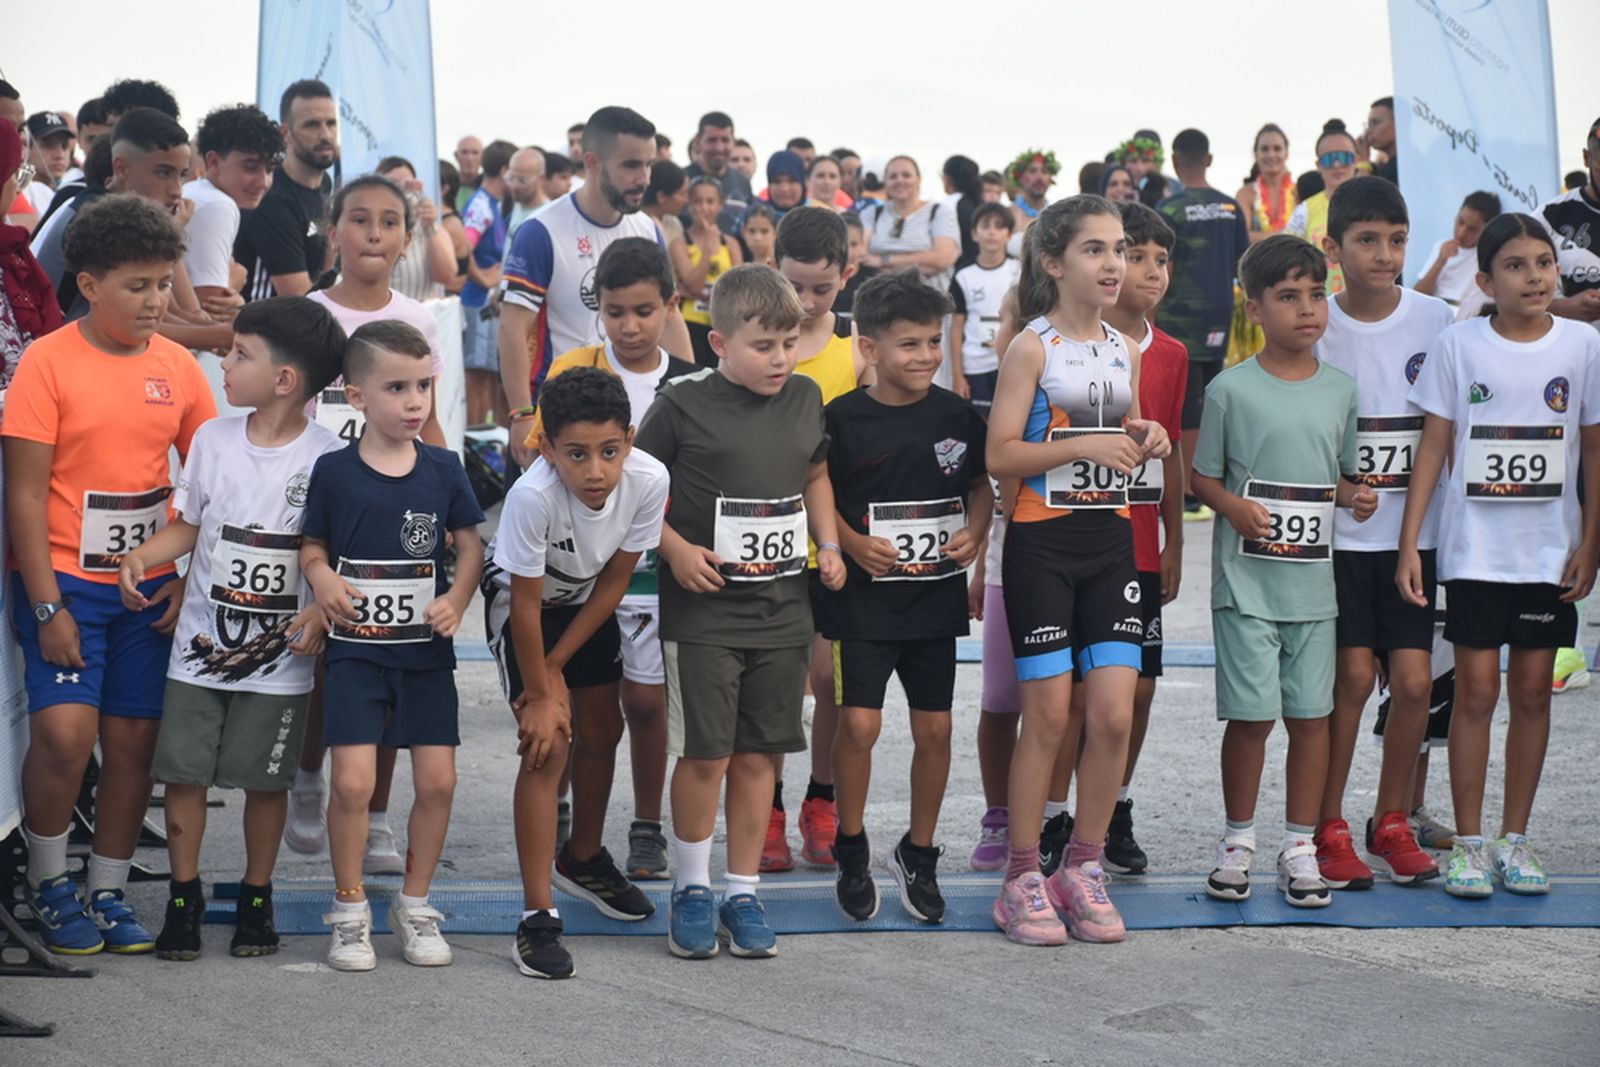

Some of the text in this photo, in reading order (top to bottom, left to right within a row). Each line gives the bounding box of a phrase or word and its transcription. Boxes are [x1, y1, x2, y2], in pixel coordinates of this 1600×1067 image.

[1560, 222, 1592, 250] 26
[1358, 444, 1413, 473] 371
[1485, 453, 1547, 483] 369
[106, 517, 157, 554] 331
[1263, 512, 1322, 545] 393
[740, 529, 795, 562] 368
[227, 557, 287, 594] 363
[349, 593, 415, 625] 385
